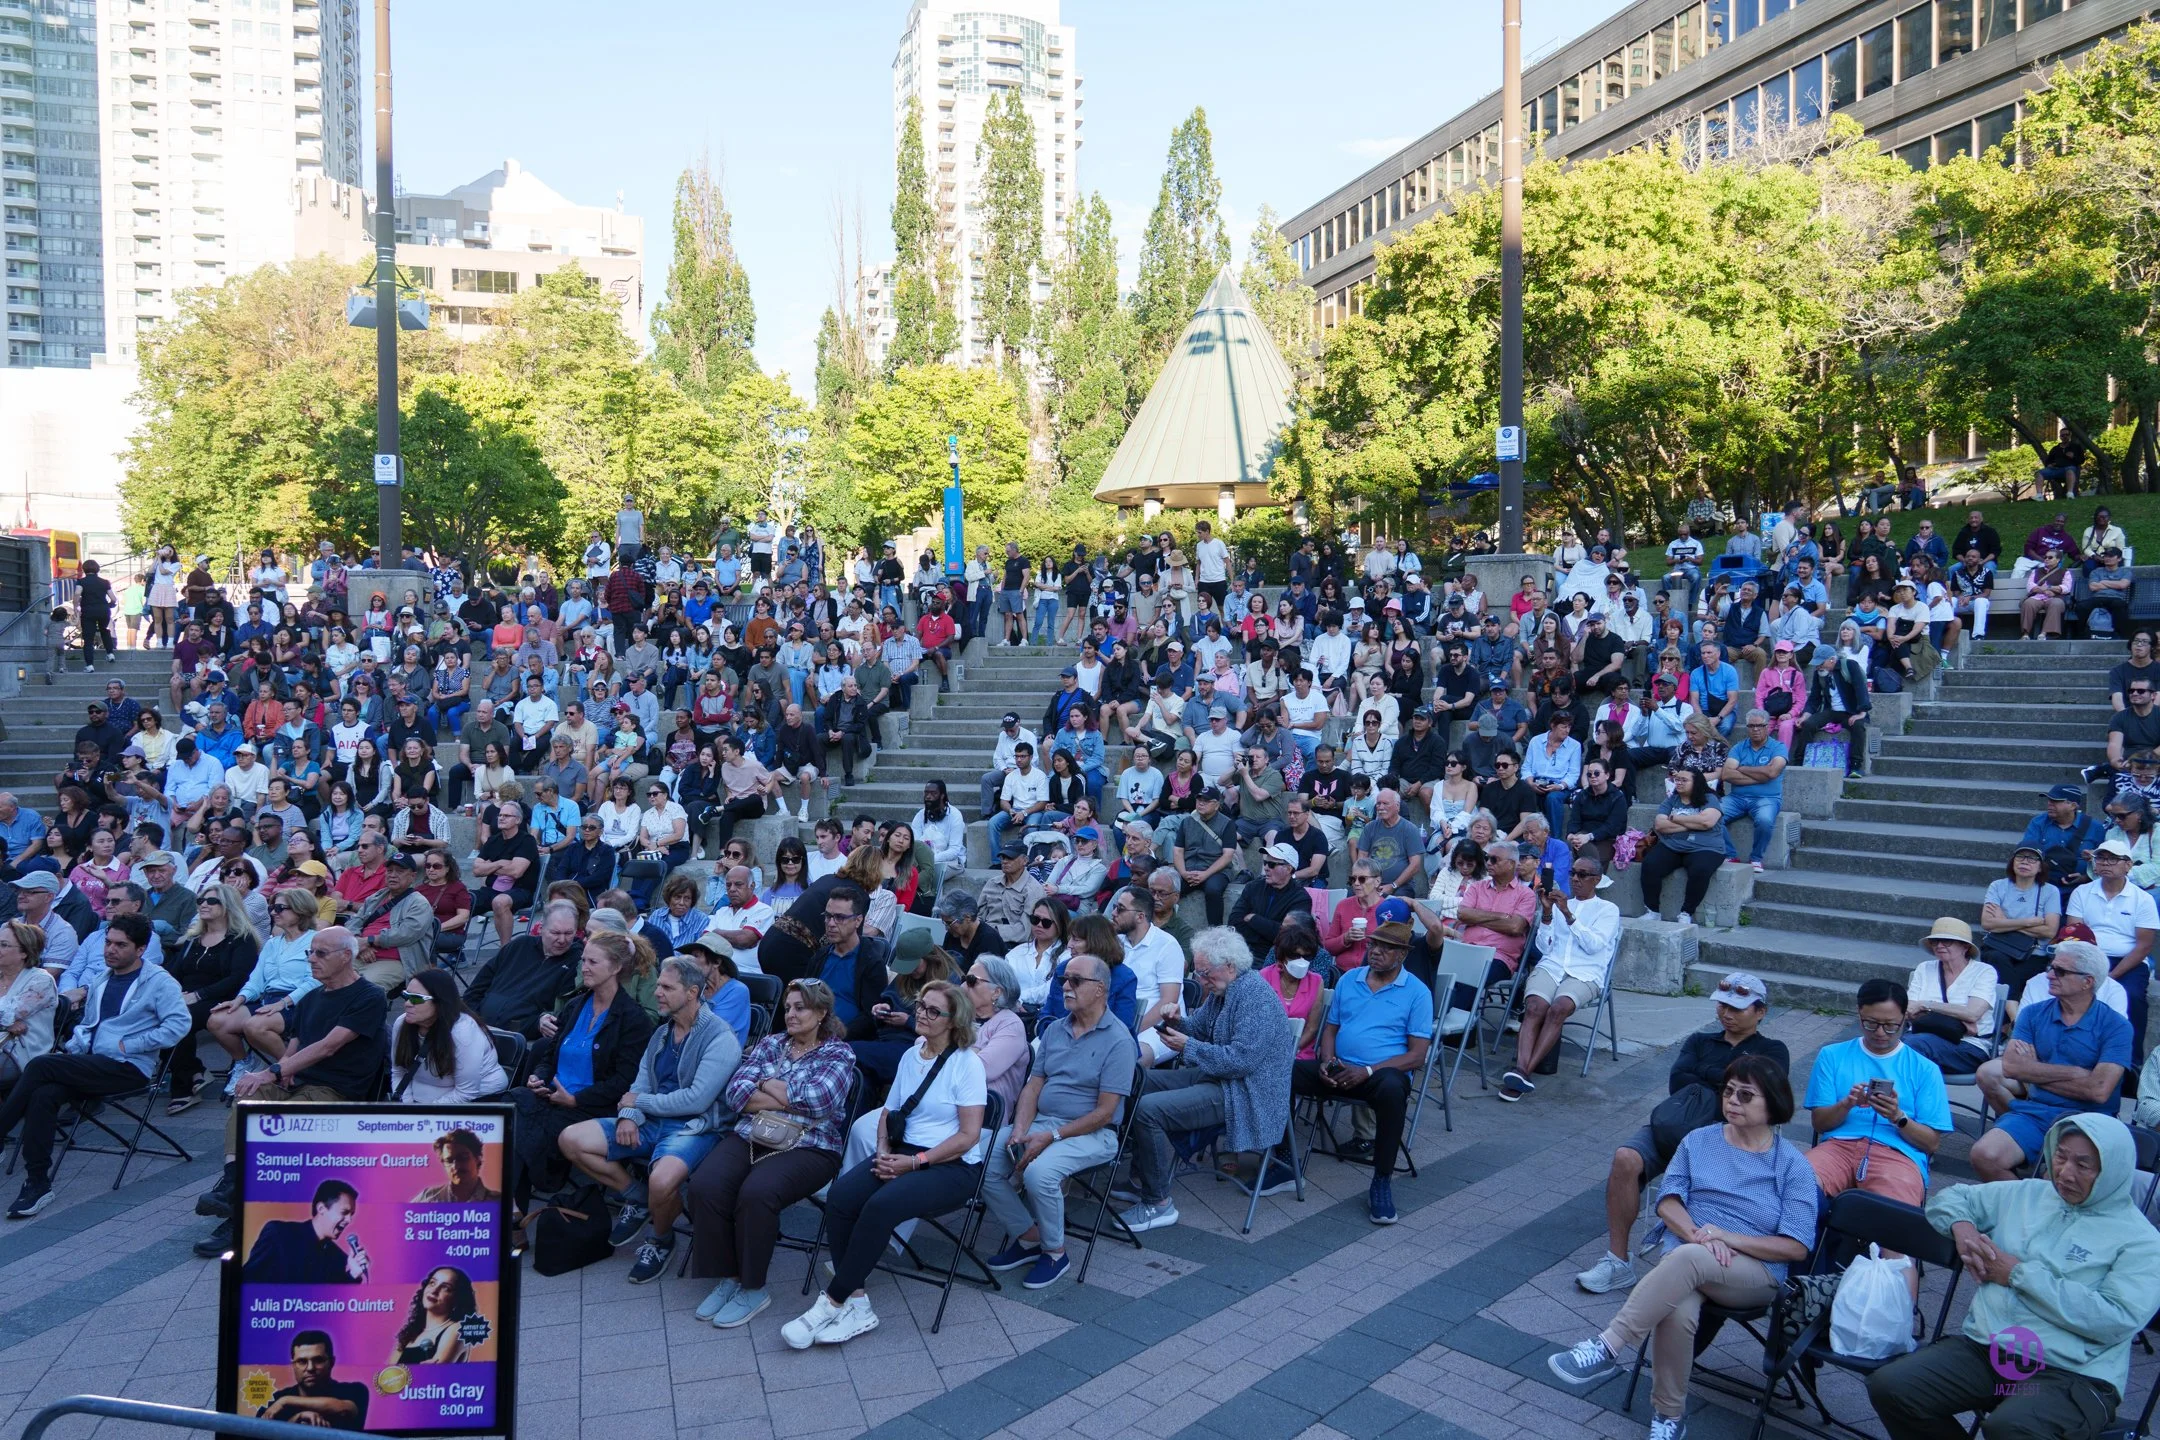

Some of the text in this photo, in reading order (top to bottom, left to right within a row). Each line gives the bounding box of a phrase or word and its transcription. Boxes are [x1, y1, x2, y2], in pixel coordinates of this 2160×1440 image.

[338, 740, 359, 749] AIA
[357, 1120, 414, 1133] September
[464, 1120, 495, 1133] Stage
[256, 1152, 429, 1168] Samuel Lechasseur Quartet
[257, 1169, 300, 1184] 2:00 pm
[404, 1209, 491, 1226] Santiago Moa
[404, 1226, 490, 1240] & su Team-ba
[446, 1245, 490, 1258] 4:00 pm
[250, 1298, 394, 1313] Julia D'Ascanio Quintet
[251, 1317, 295, 1331] 6:00 pm
[399, 1382, 485, 1402] Justin Gray
[440, 1404, 484, 1417] 8:00 pm
